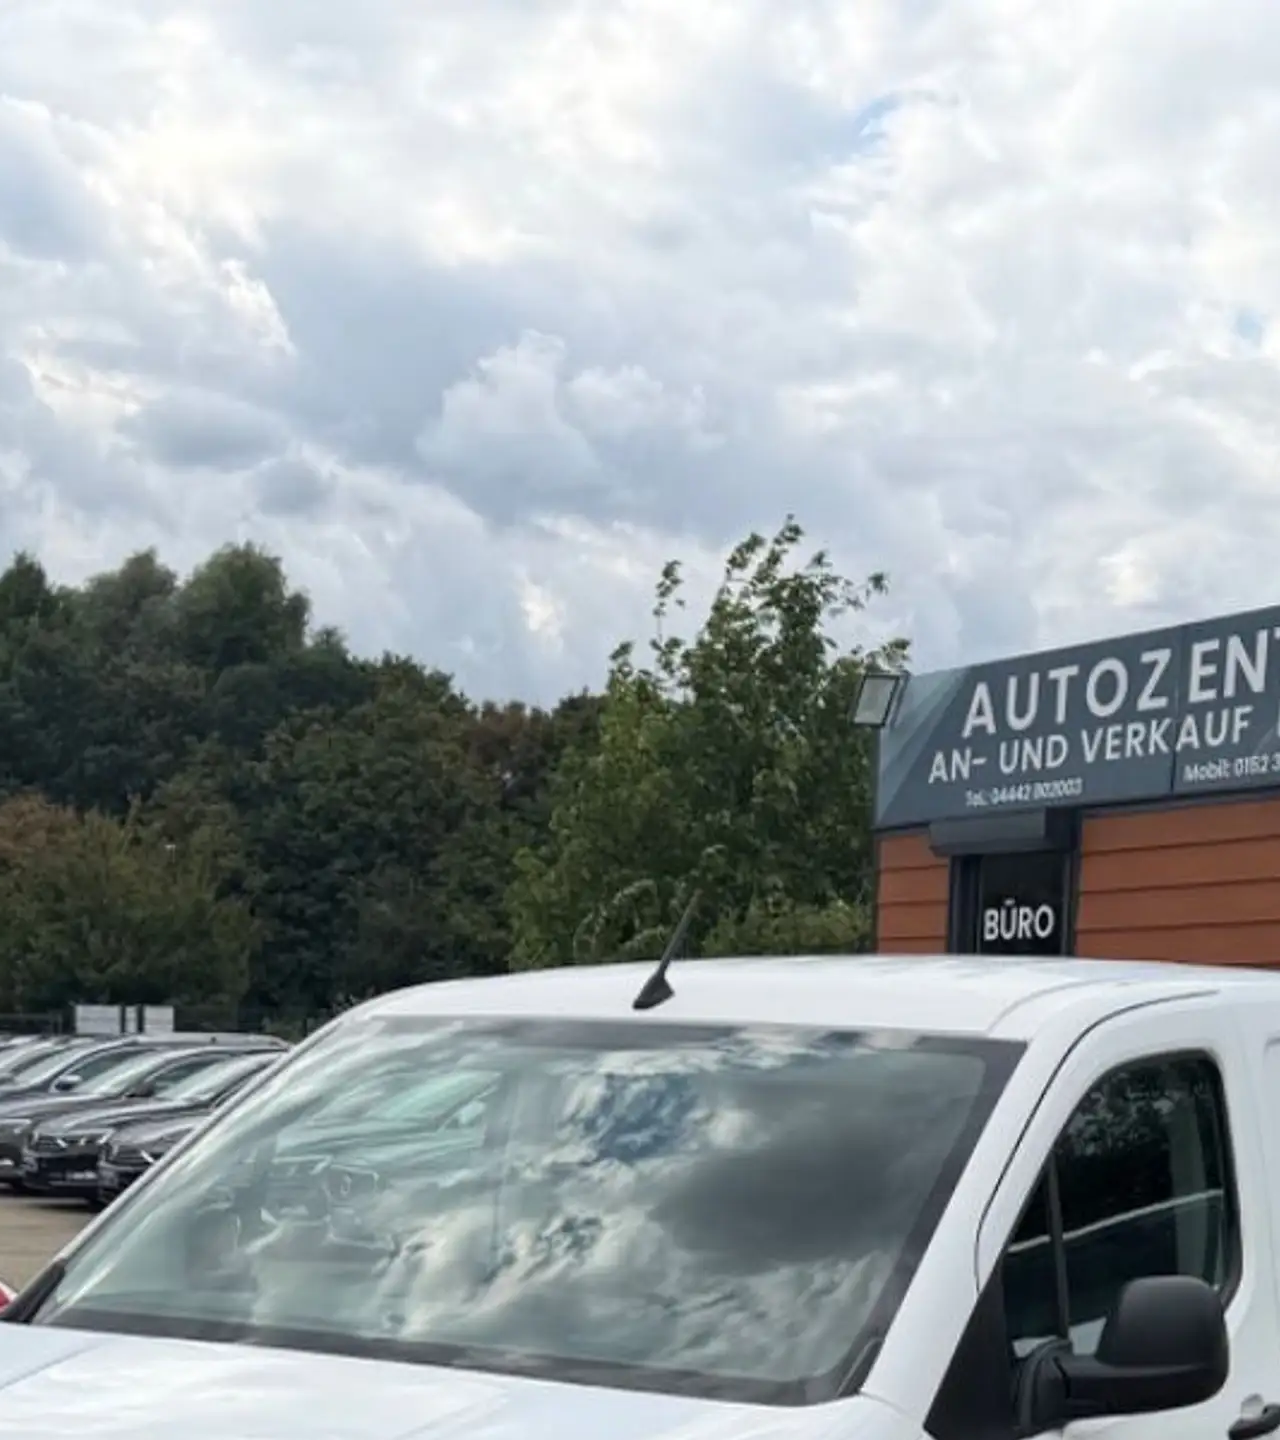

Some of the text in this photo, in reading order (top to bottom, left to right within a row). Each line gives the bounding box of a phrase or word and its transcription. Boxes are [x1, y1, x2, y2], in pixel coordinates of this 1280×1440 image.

[928, 747, 986, 784] AN-
[999, 734, 1068, 774] UND
[1082, 706, 1253, 764] VERKAUF
[983, 897, 1054, 941] BÜRO
